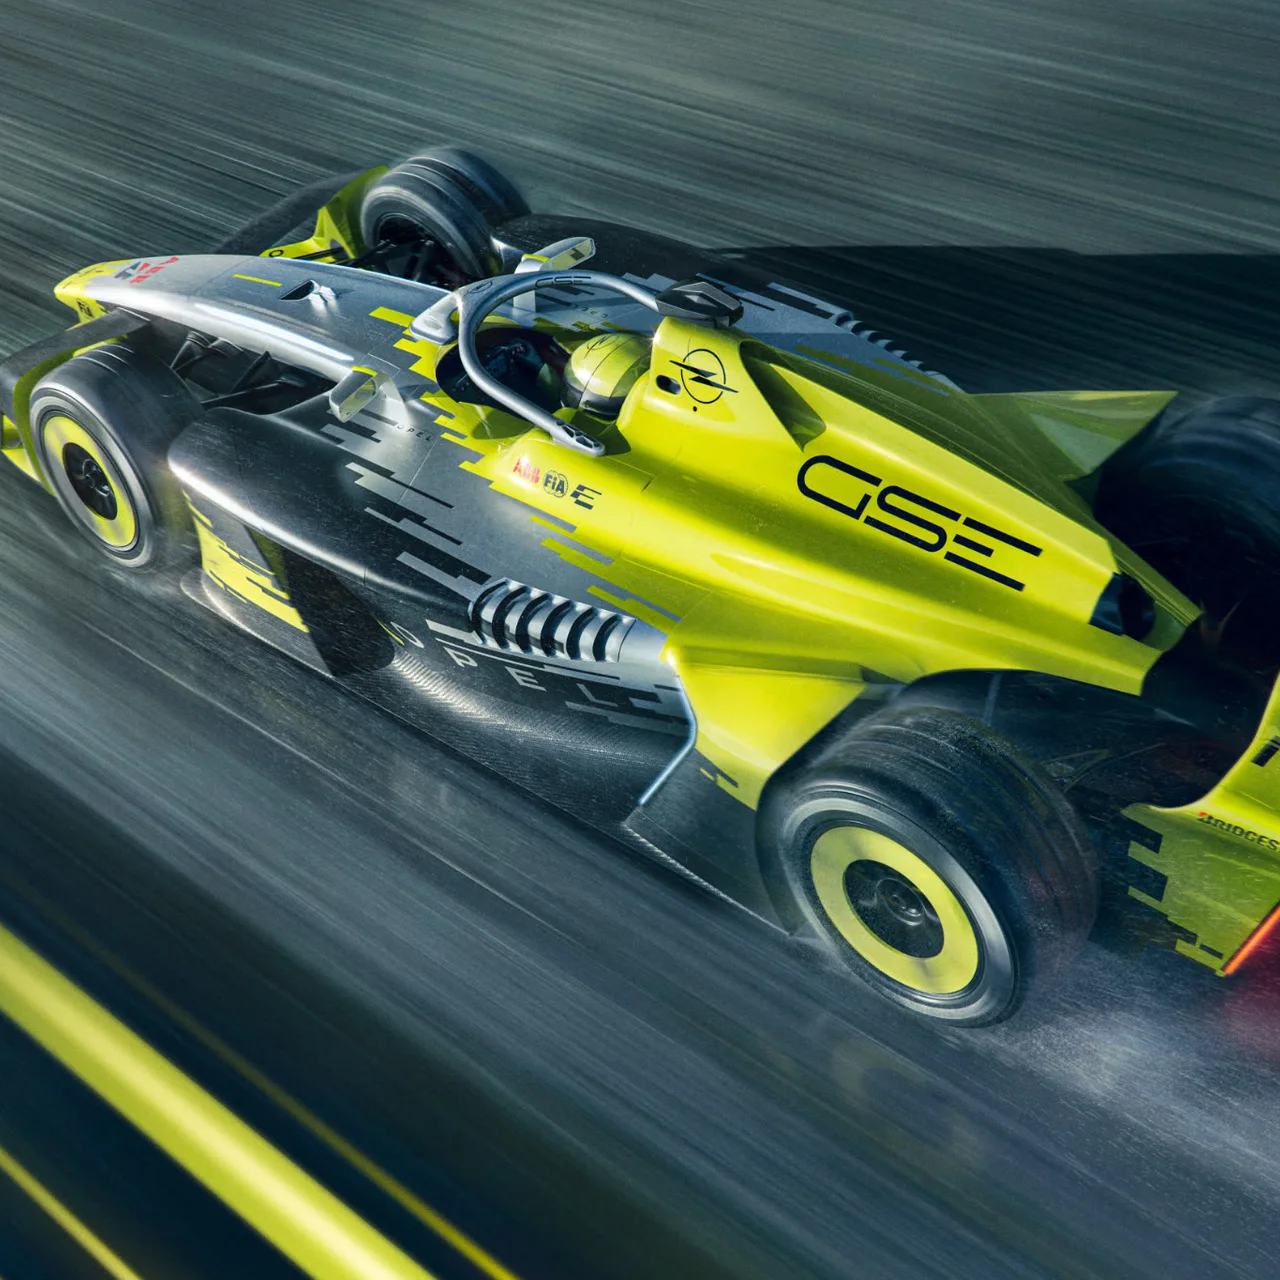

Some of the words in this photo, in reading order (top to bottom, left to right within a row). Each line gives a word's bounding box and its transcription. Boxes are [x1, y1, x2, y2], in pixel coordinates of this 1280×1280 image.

[535, 275, 591, 288] GSE
[512, 458, 541, 484] ABB
[797, 455, 1043, 592] GSE
[389, 621, 618, 707] OPEL
